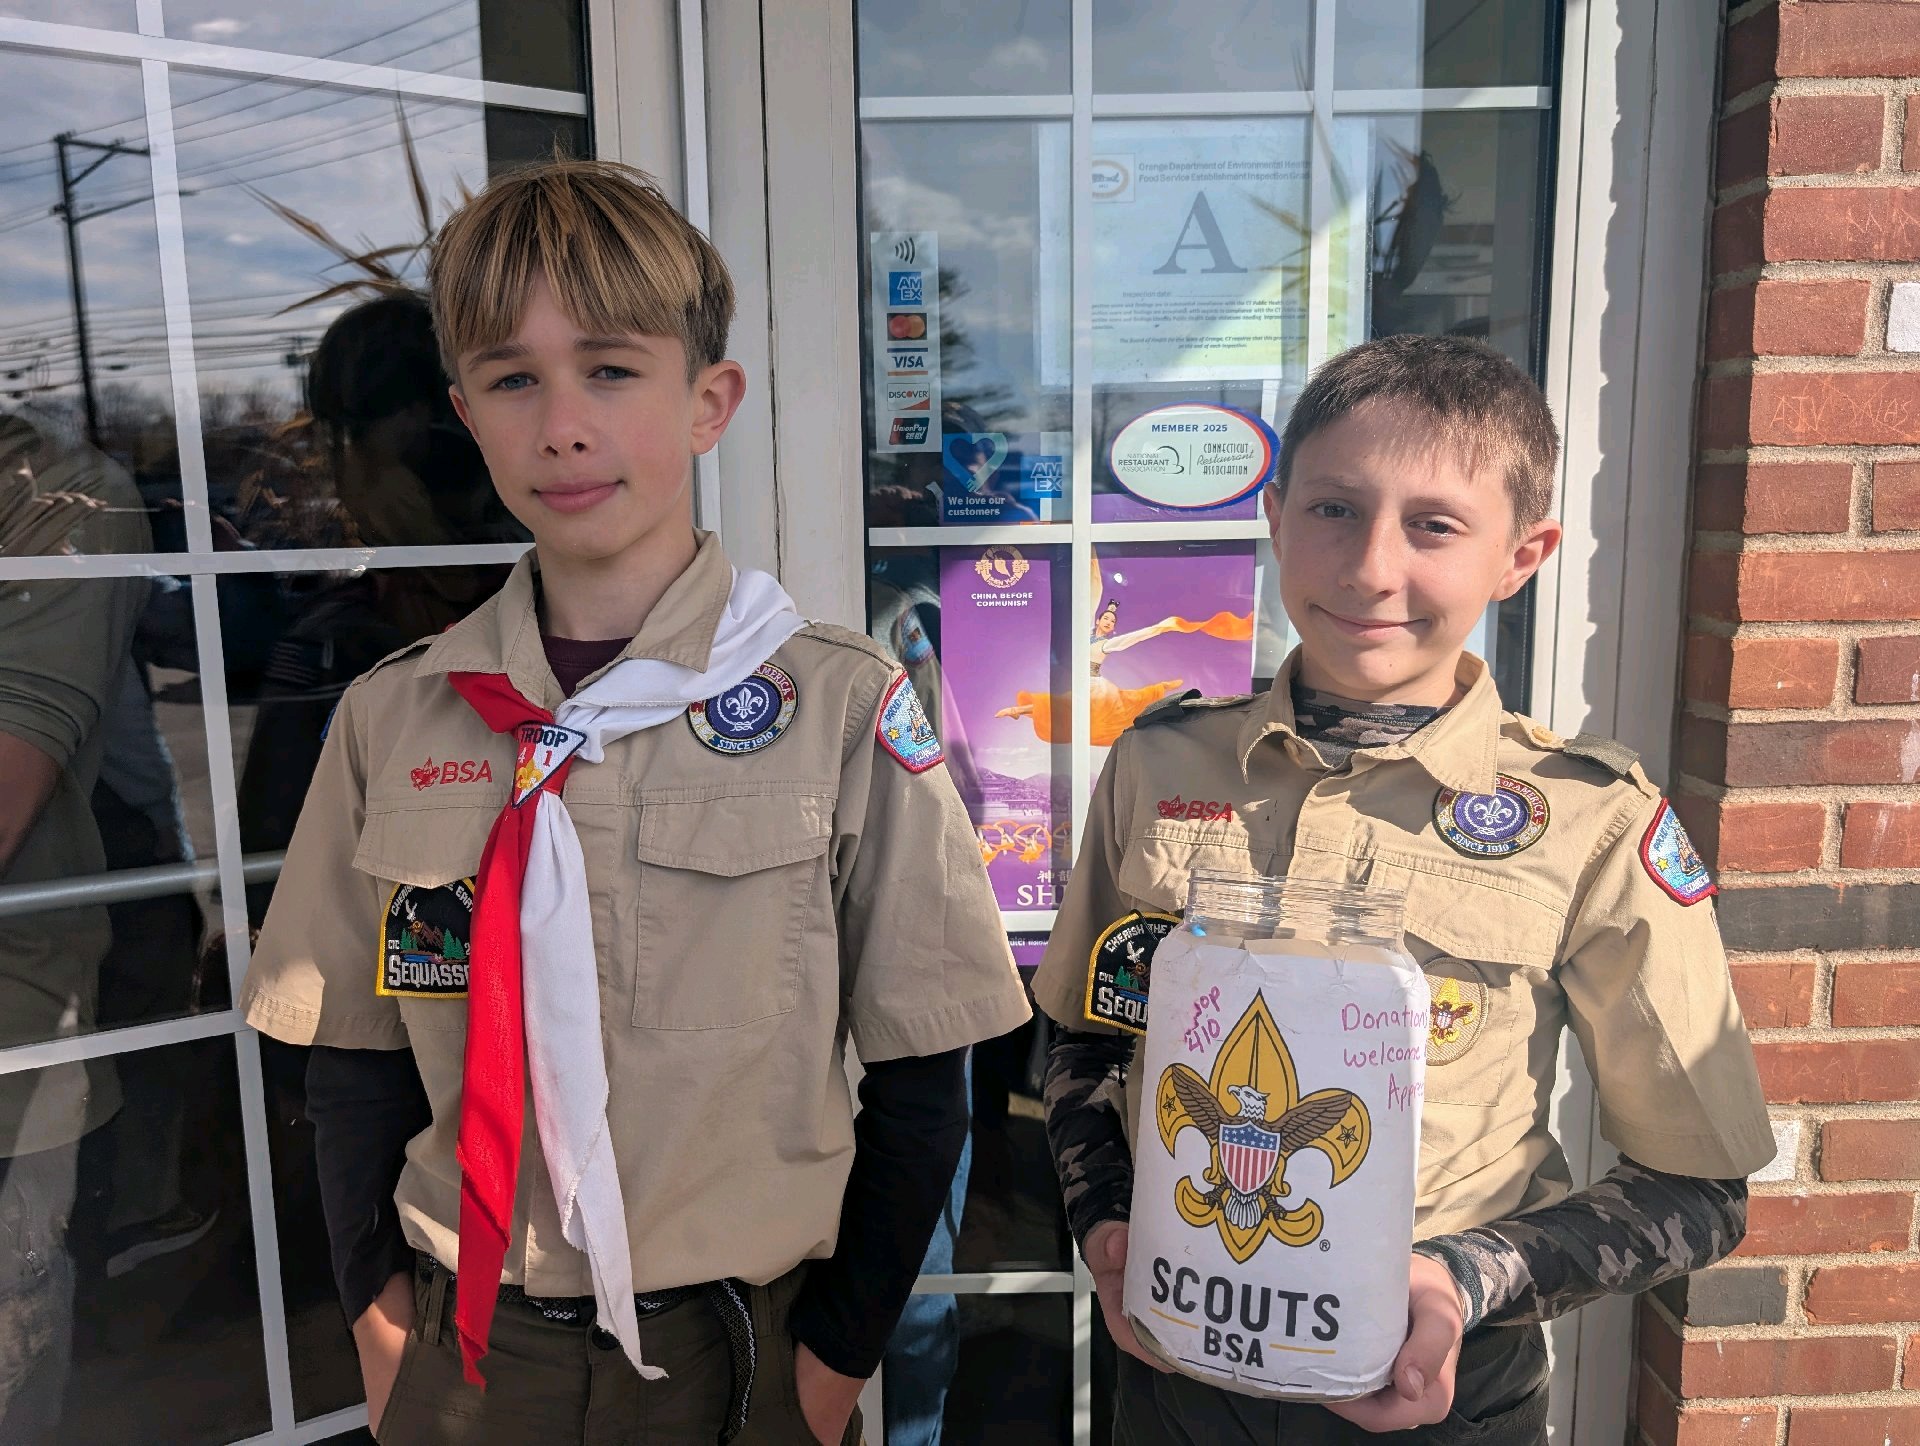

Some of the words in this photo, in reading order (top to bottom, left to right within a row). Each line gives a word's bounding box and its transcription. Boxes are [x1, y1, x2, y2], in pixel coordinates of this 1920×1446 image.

[1169, 162, 1216, 171] Department
[1227, 160, 1283, 170] Environmental
[1138, 174, 1159, 183] Food
[1160, 173, 1190, 183] Service
[1191, 172, 1246, 182] Establishment
[1247, 171, 1288, 181] Inspection
[1153, 190, 1248, 275] A
[899, 277, 922, 289] AM
[902, 289, 922, 300] EX
[892, 356, 924, 369] VISA
[889, 391, 928, 399] DISCOVER
[893, 424, 927, 436] UnionPay
[1151, 424, 1199, 433] MEMBER
[1203, 424, 1228, 432] 2025
[1203, 443, 1249, 454] CONNECTICUT
[1197, 449, 1254, 466] Restaurant
[1031, 463, 1062, 478] AM
[1203, 465, 1248, 475] ASSOCIATION
[1035, 478, 1063, 492] EX
[948, 497, 963, 505] We
[965, 497, 986, 505] love
[948, 508, 1001, 516] customers
[520, 727, 569, 748] TROOP
[717, 739, 750, 751] SINCE
[752, 731, 774, 748] 1910
[518, 747, 527, 763] 4
[543, 750, 553, 767] 1
[440, 760, 493, 785] BSA
[1513, 782, 1544, 817] AMERICA
[1185, 801, 1234, 823] BSA
[1454, 833, 1484, 852] SINCE
[1487, 843, 1510, 853] 1910
[1016, 884, 1067, 906] SH
[1104, 923, 1145, 953] CHERISH
[1147, 924, 1168, 934] THE
[1096, 986, 1149, 1024] SEQU
[1189, 1018, 1221, 1053] 410
[1151, 1256, 1341, 1342] SCOUTS
[1203, 1325, 1265, 1369] BSA
